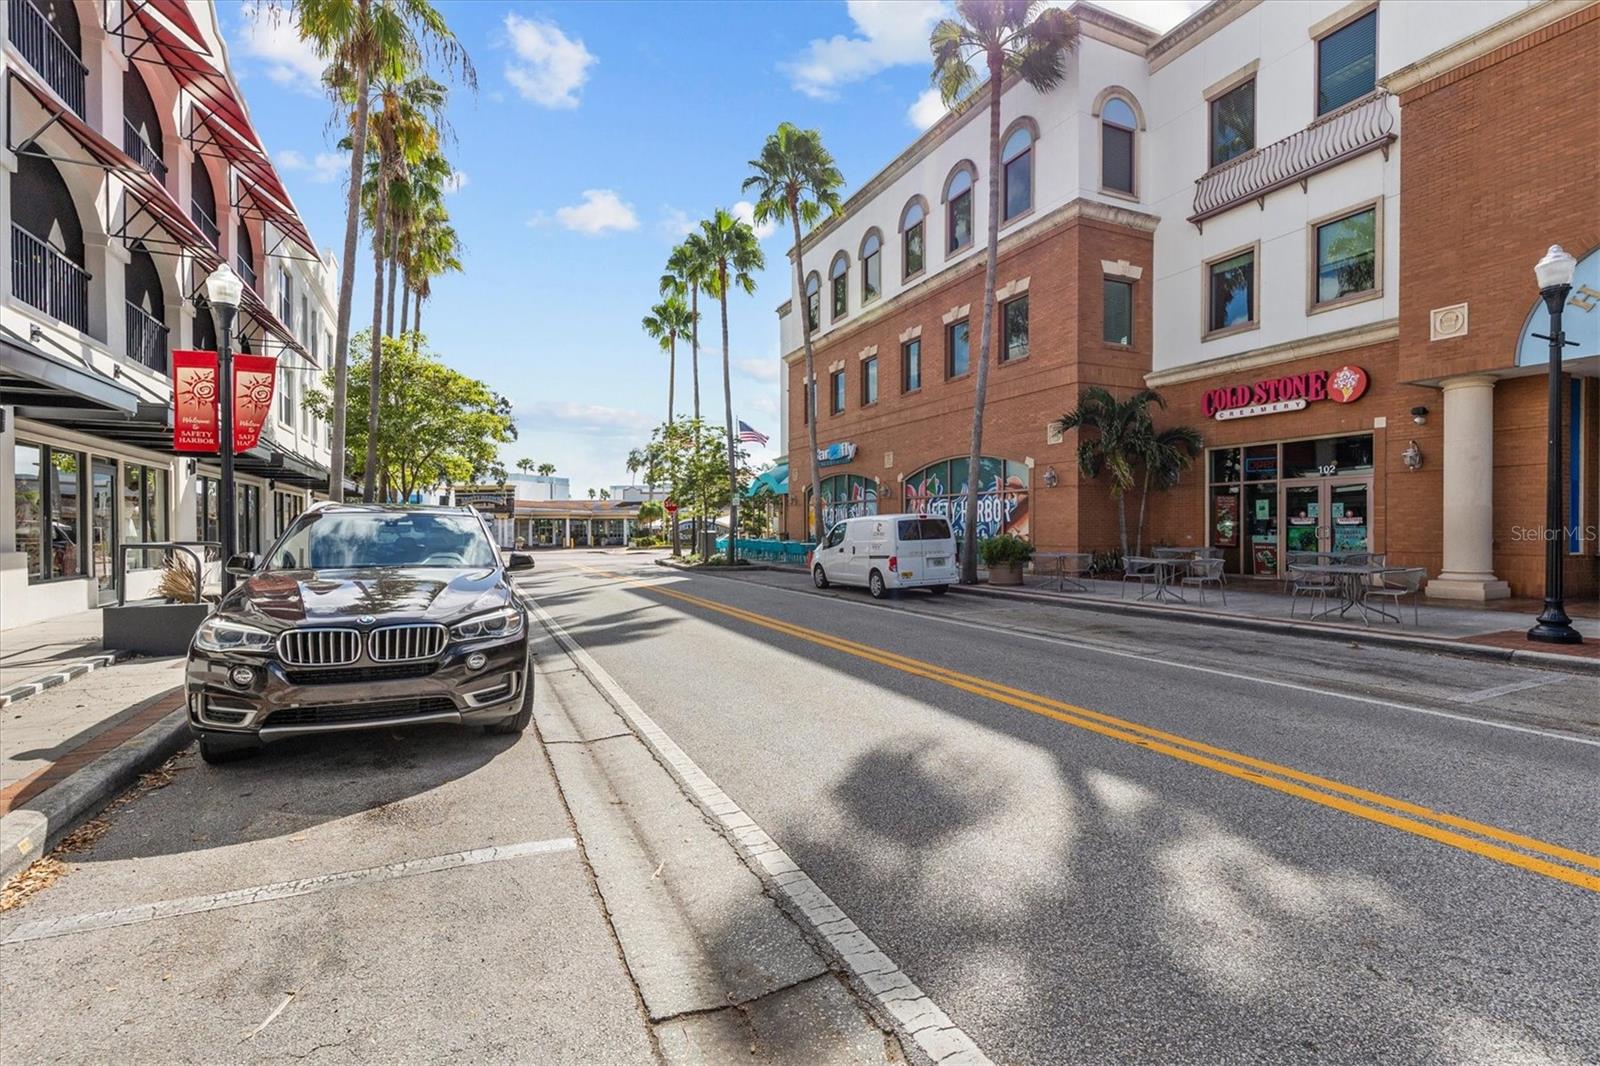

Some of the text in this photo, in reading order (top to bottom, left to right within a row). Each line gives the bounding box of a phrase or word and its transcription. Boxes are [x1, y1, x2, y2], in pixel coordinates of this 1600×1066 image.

[1202, 371, 1326, 417] COLD STONE
[1219, 401, 1302, 419] CREAMERY
[179, 437, 215, 445] HARBOR
[1318, 465, 1336, 474] 102
[960, 498, 1011, 522] HRBOR
